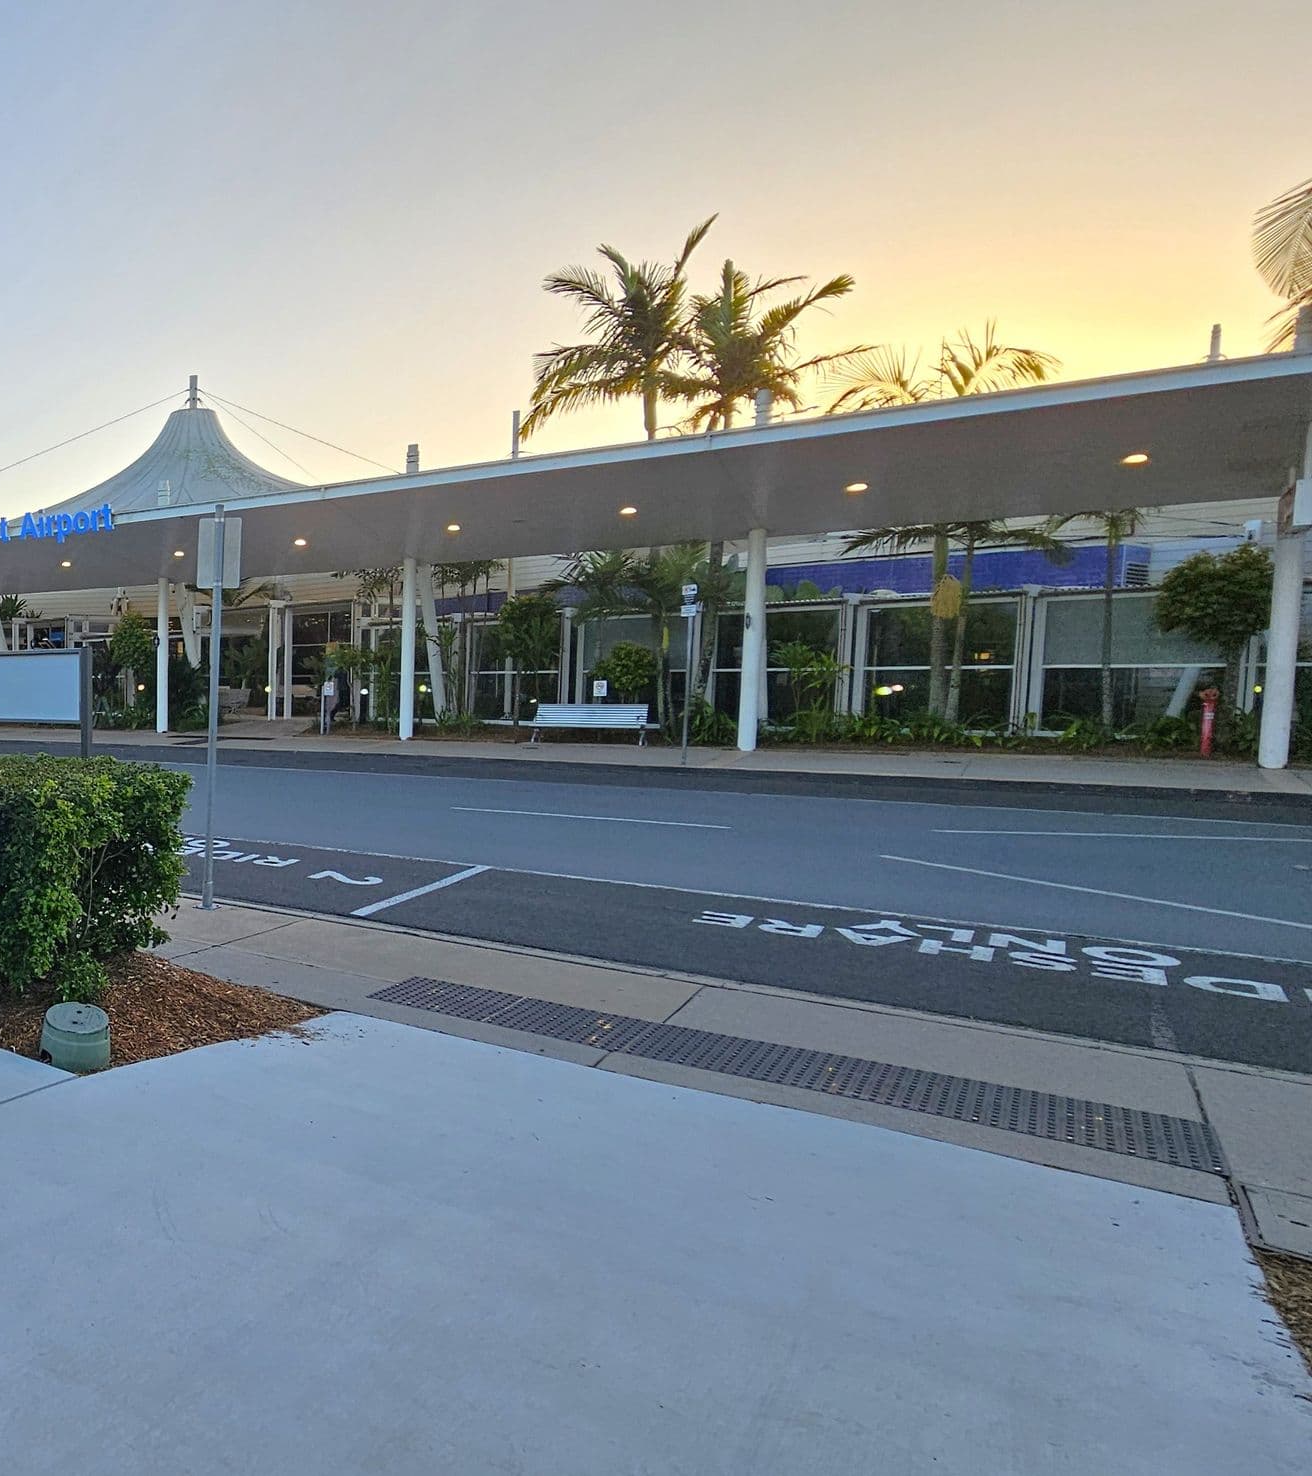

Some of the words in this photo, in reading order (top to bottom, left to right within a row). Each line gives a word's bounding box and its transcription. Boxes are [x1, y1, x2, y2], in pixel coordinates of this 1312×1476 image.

[20, 503, 115, 544] Airport
[306, 869, 384, 886] 2
[691, 909, 1079, 972] SHARE
[849, 919, 1182, 967] ONLY
